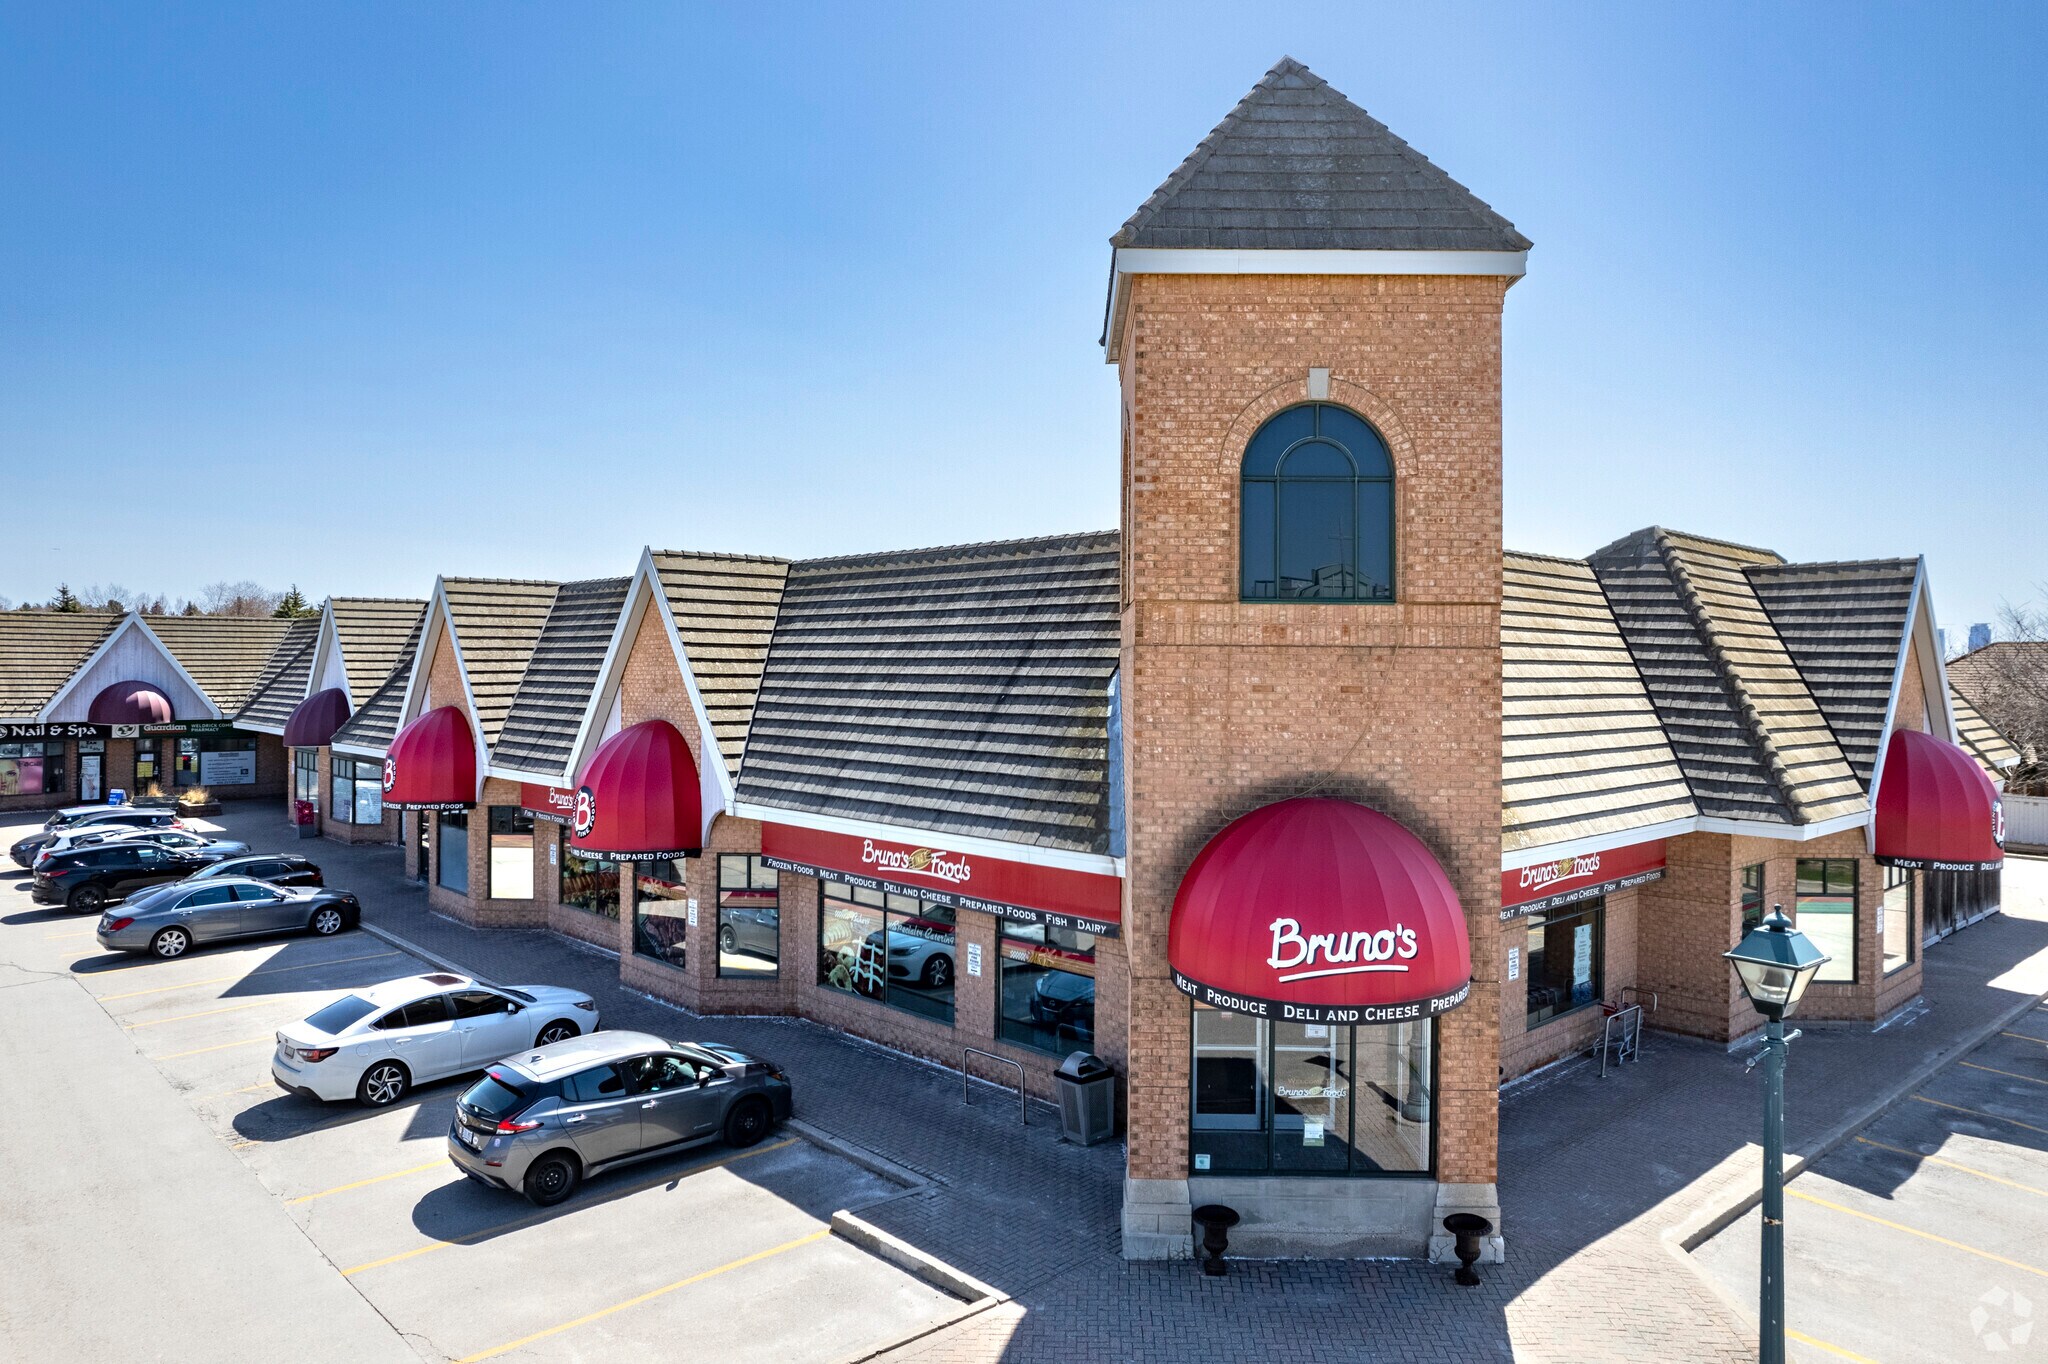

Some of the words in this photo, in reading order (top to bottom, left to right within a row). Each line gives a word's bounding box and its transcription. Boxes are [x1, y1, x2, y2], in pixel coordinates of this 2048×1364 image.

[11, 725, 46, 737] Nail
[50, 725, 63, 736] &
[67, 724, 97, 738] Spa
[143, 723, 187, 732] Guardian
[384, 759, 393, 787] B
[548, 787, 574, 807] Bruno's
[575, 792, 591, 831] B
[580, 850, 604, 860] CHEESE
[610, 852, 655, 861] PREPARED
[656, 851, 685, 860] FOODS
[862, 839, 910, 869] Bruno's
[930, 851, 971, 881] Foods
[1894, 858, 1924, 868] MEAT
[1933, 861, 1975, 871] PRODUCE
[1981, 862, 1995, 871] DELI
[1519, 861, 1559, 889] Bruno's
[767, 858, 792, 871] FROZEN
[793, 863, 814, 876] FOODS
[819, 869, 839, 881] MEAT
[844, 874, 877, 889] PRODUCE
[884, 882, 900, 895] DELI
[902, 887, 918, 897] AND
[920, 889, 952, 904] CHEESE
[959, 897, 1004, 915] PREPARED
[1006, 906, 1037, 921] FOODS
[1045, 913, 1068, 927] FISH
[1077, 919, 1107, 934] DAIRY
[1519, 901, 1547, 915] PRODUCE
[1551, 896, 1565, 906] DELI
[1565, 893, 1579, 902] AND
[1578, 887, 1600, 899] CHEESE
[1603, 883, 1617, 892] FISH
[1620, 876, 1646, 888] PREPARED
[1646, 871, 1661, 882] FOODS
[1266, 917, 1418, 969] Bruno's
[1176, 973, 1198, 996] MEAT
[1207, 988, 1267, 1016] PRODUCE
[1283, 1004, 1320, 1021] DELI
[1326, 1009, 1359, 1022] AND
[1365, 1004, 1420, 1021] CHEESE
[1430, 985, 1469, 1013] PREPARED
[1277, 1086, 1309, 1097] Bruno's
